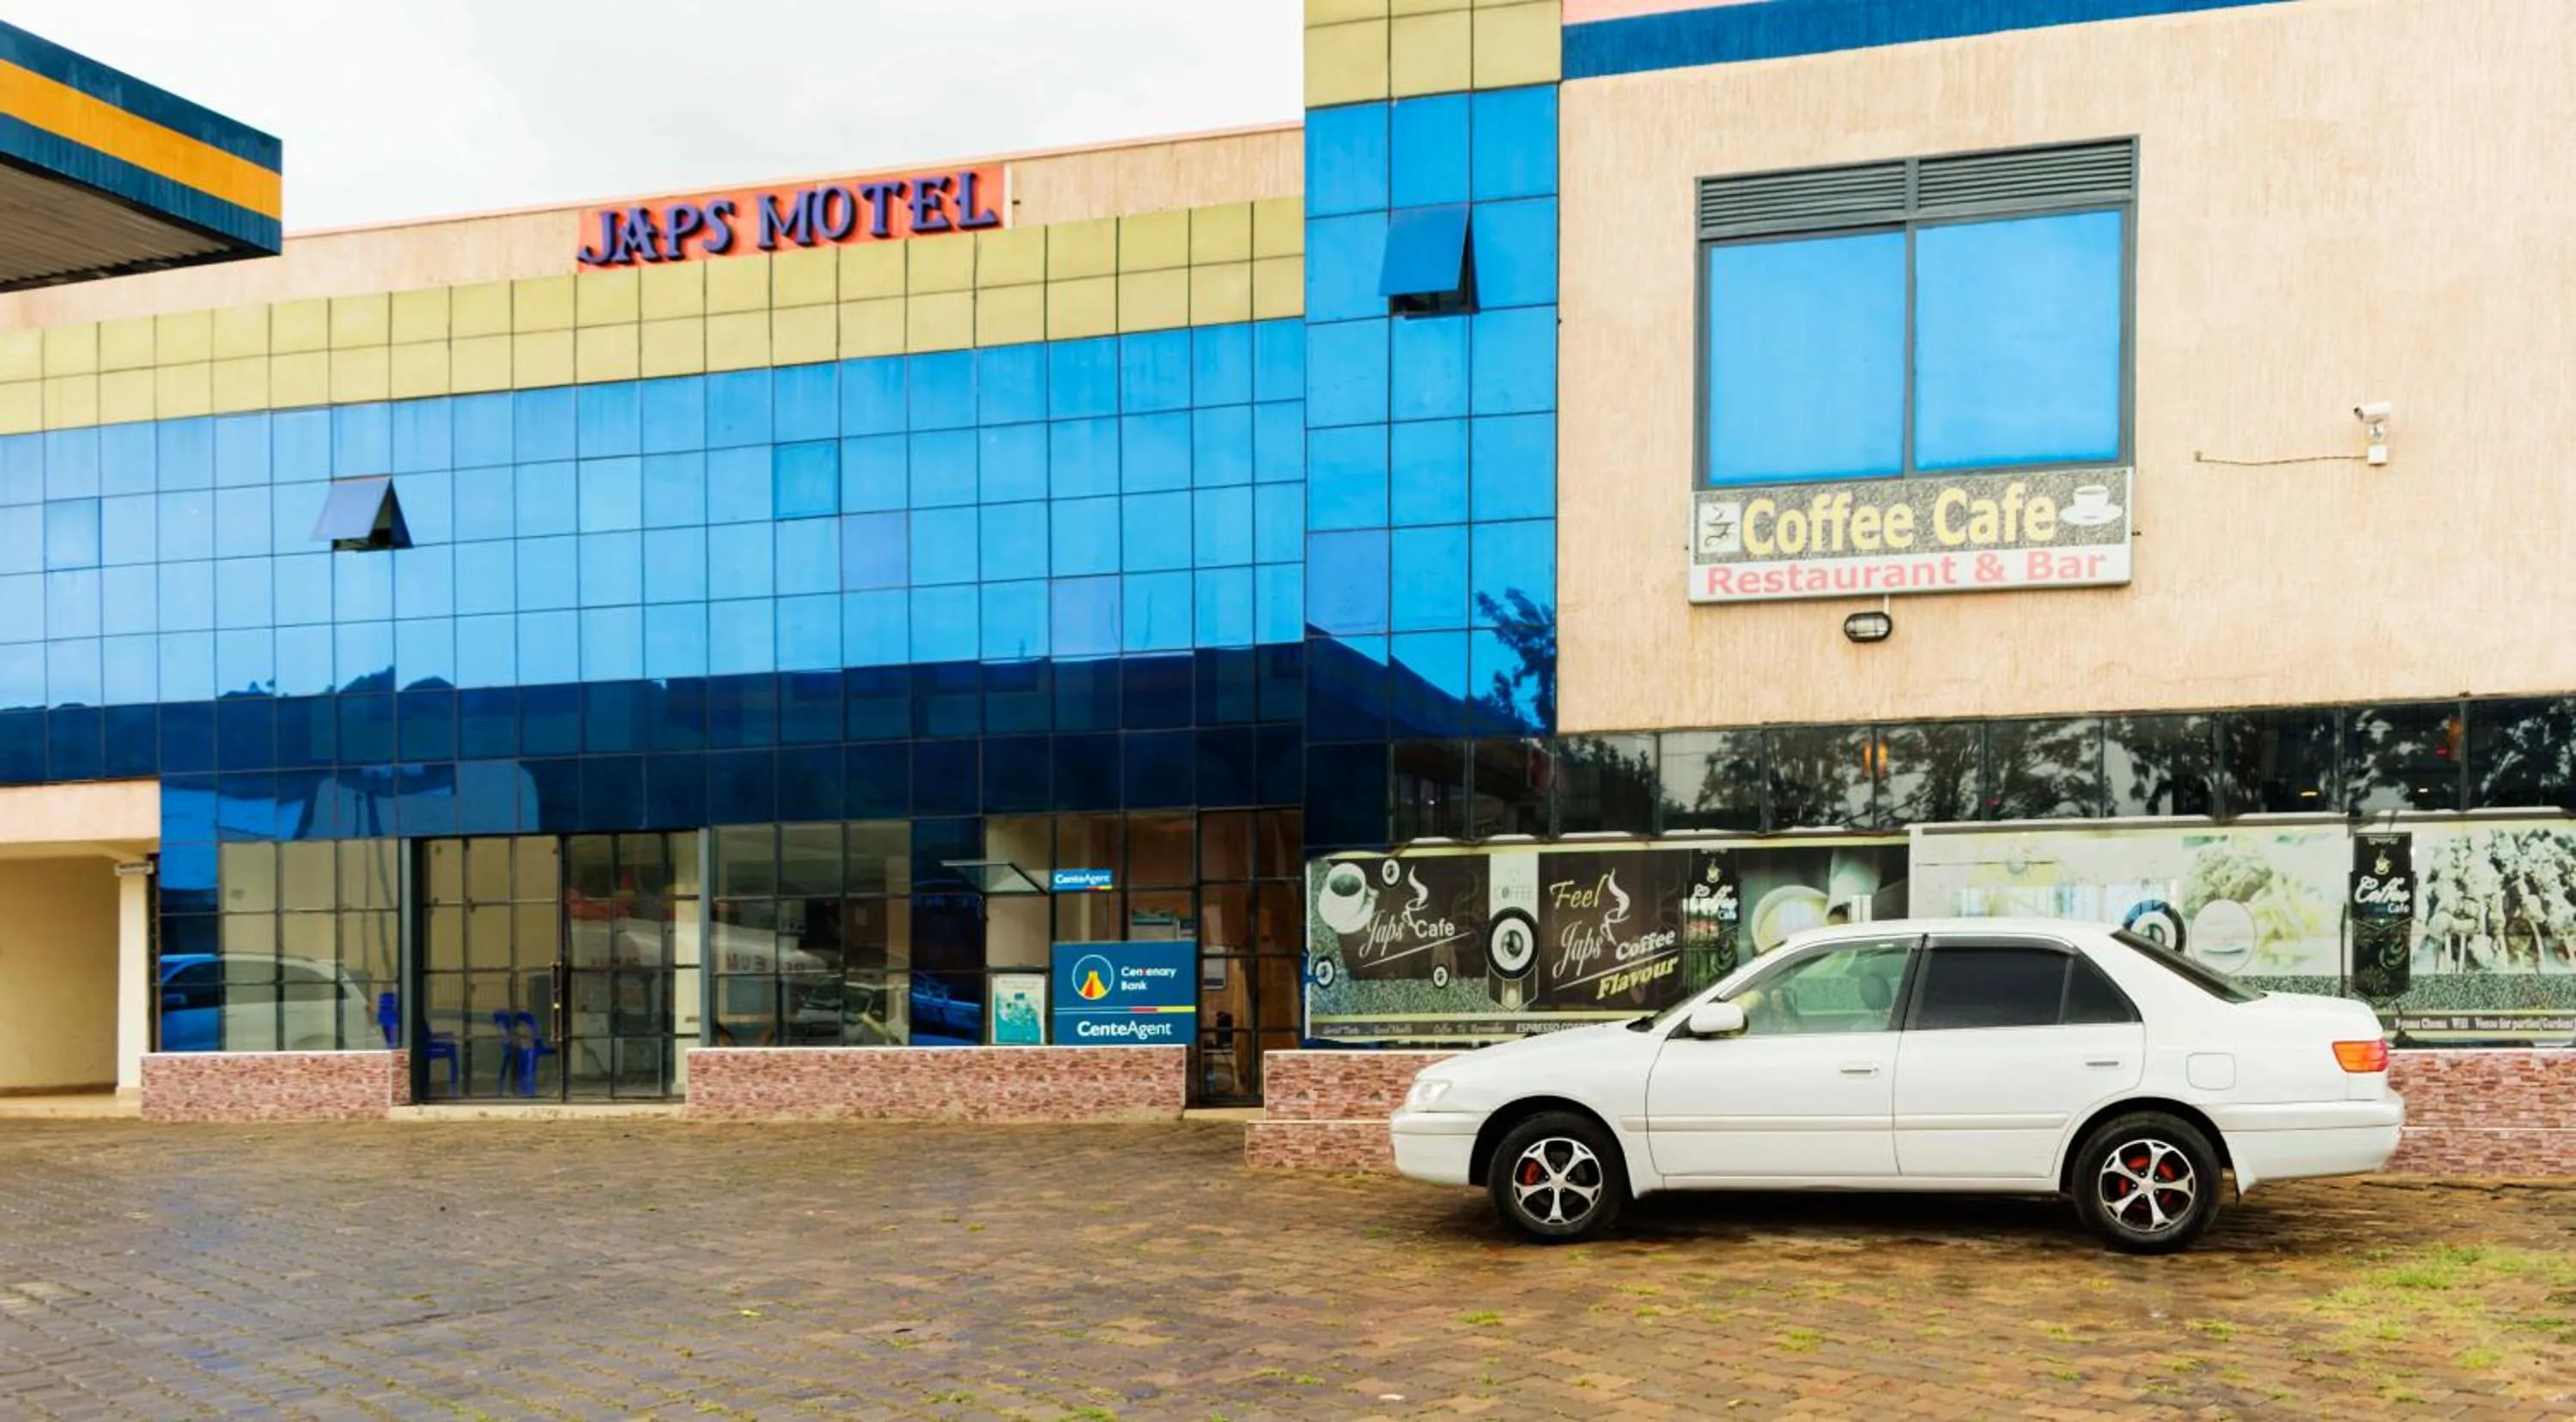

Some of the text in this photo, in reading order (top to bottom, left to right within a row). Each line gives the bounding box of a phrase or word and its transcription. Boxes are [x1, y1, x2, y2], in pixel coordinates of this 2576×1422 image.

[578, 169, 1001, 266] JAPS MOTEL
[1743, 481, 2057, 556] Coffee Cafe
[1707, 548, 2105, 596] Restaurant & Bar
[1054, 873, 1110, 884] CenteAgent
[1549, 873, 1610, 909] Feel
[1359, 909, 1455, 959] Japs Cafe
[1552, 920, 1676, 979] Japs Coffee
[1121, 966, 1177, 978] Centenary
[1121, 981, 1147, 991] Bank
[1596, 957, 1679, 1000] Flavour
[1077, 1019, 1173, 1040] CenteAgent
